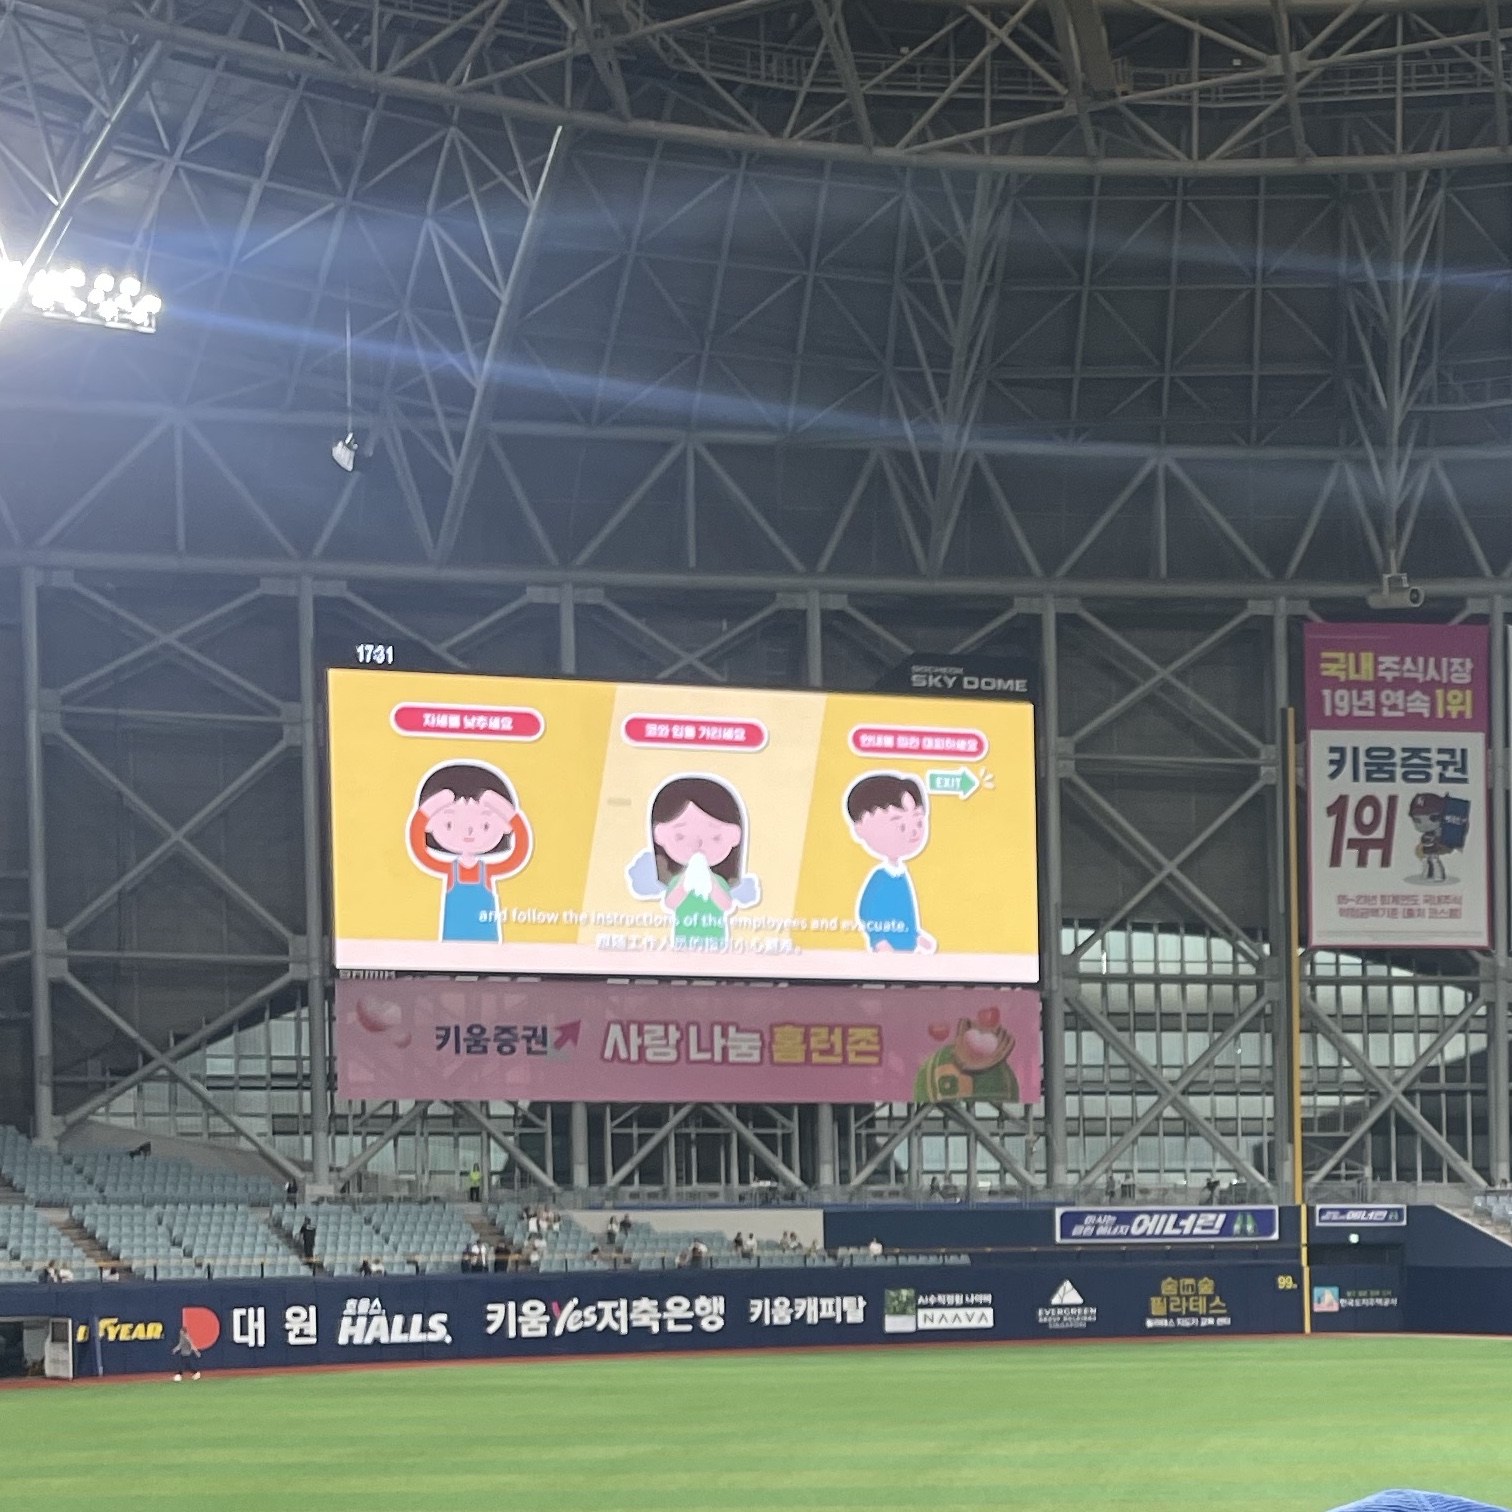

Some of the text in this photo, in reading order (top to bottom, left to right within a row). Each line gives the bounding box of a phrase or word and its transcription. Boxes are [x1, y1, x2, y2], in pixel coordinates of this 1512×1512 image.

[911, 674, 1028, 692] SKY DOME
[1320, 651, 1474, 684] 국내 주식시장
[1321, 689, 1473, 719] 19년 연속 1위
[1327, 746, 1470, 785] 키움증권
[935, 776, 962, 788] EXIT
[1326, 793, 1399, 868] 1위
[478, 908, 507, 923] and
[511, 907, 559, 923] follow
[562, 909, 588, 924] the
[591, 910, 680, 927] instructions
[683, 913, 699, 927] of
[701, 914, 727, 928] the
[729, 916, 808, 934] employees
[811, 916, 838, 932] and
[434, 1023, 548, 1056] 키움증권
[603, 1020, 881, 1065] 사랑 나눔 홈런존
[1130, 1212, 1227, 1236] 에너린
[486, 1294, 726, 1339] 키움Yes저축은행
[747, 1295, 867, 1327] 키움캐피탈
[1038, 1307, 1098, 1317] EVERGREEN
[1150, 1295, 1228, 1316] 필라테스
[338, 1313, 449, 1345] HALLS
